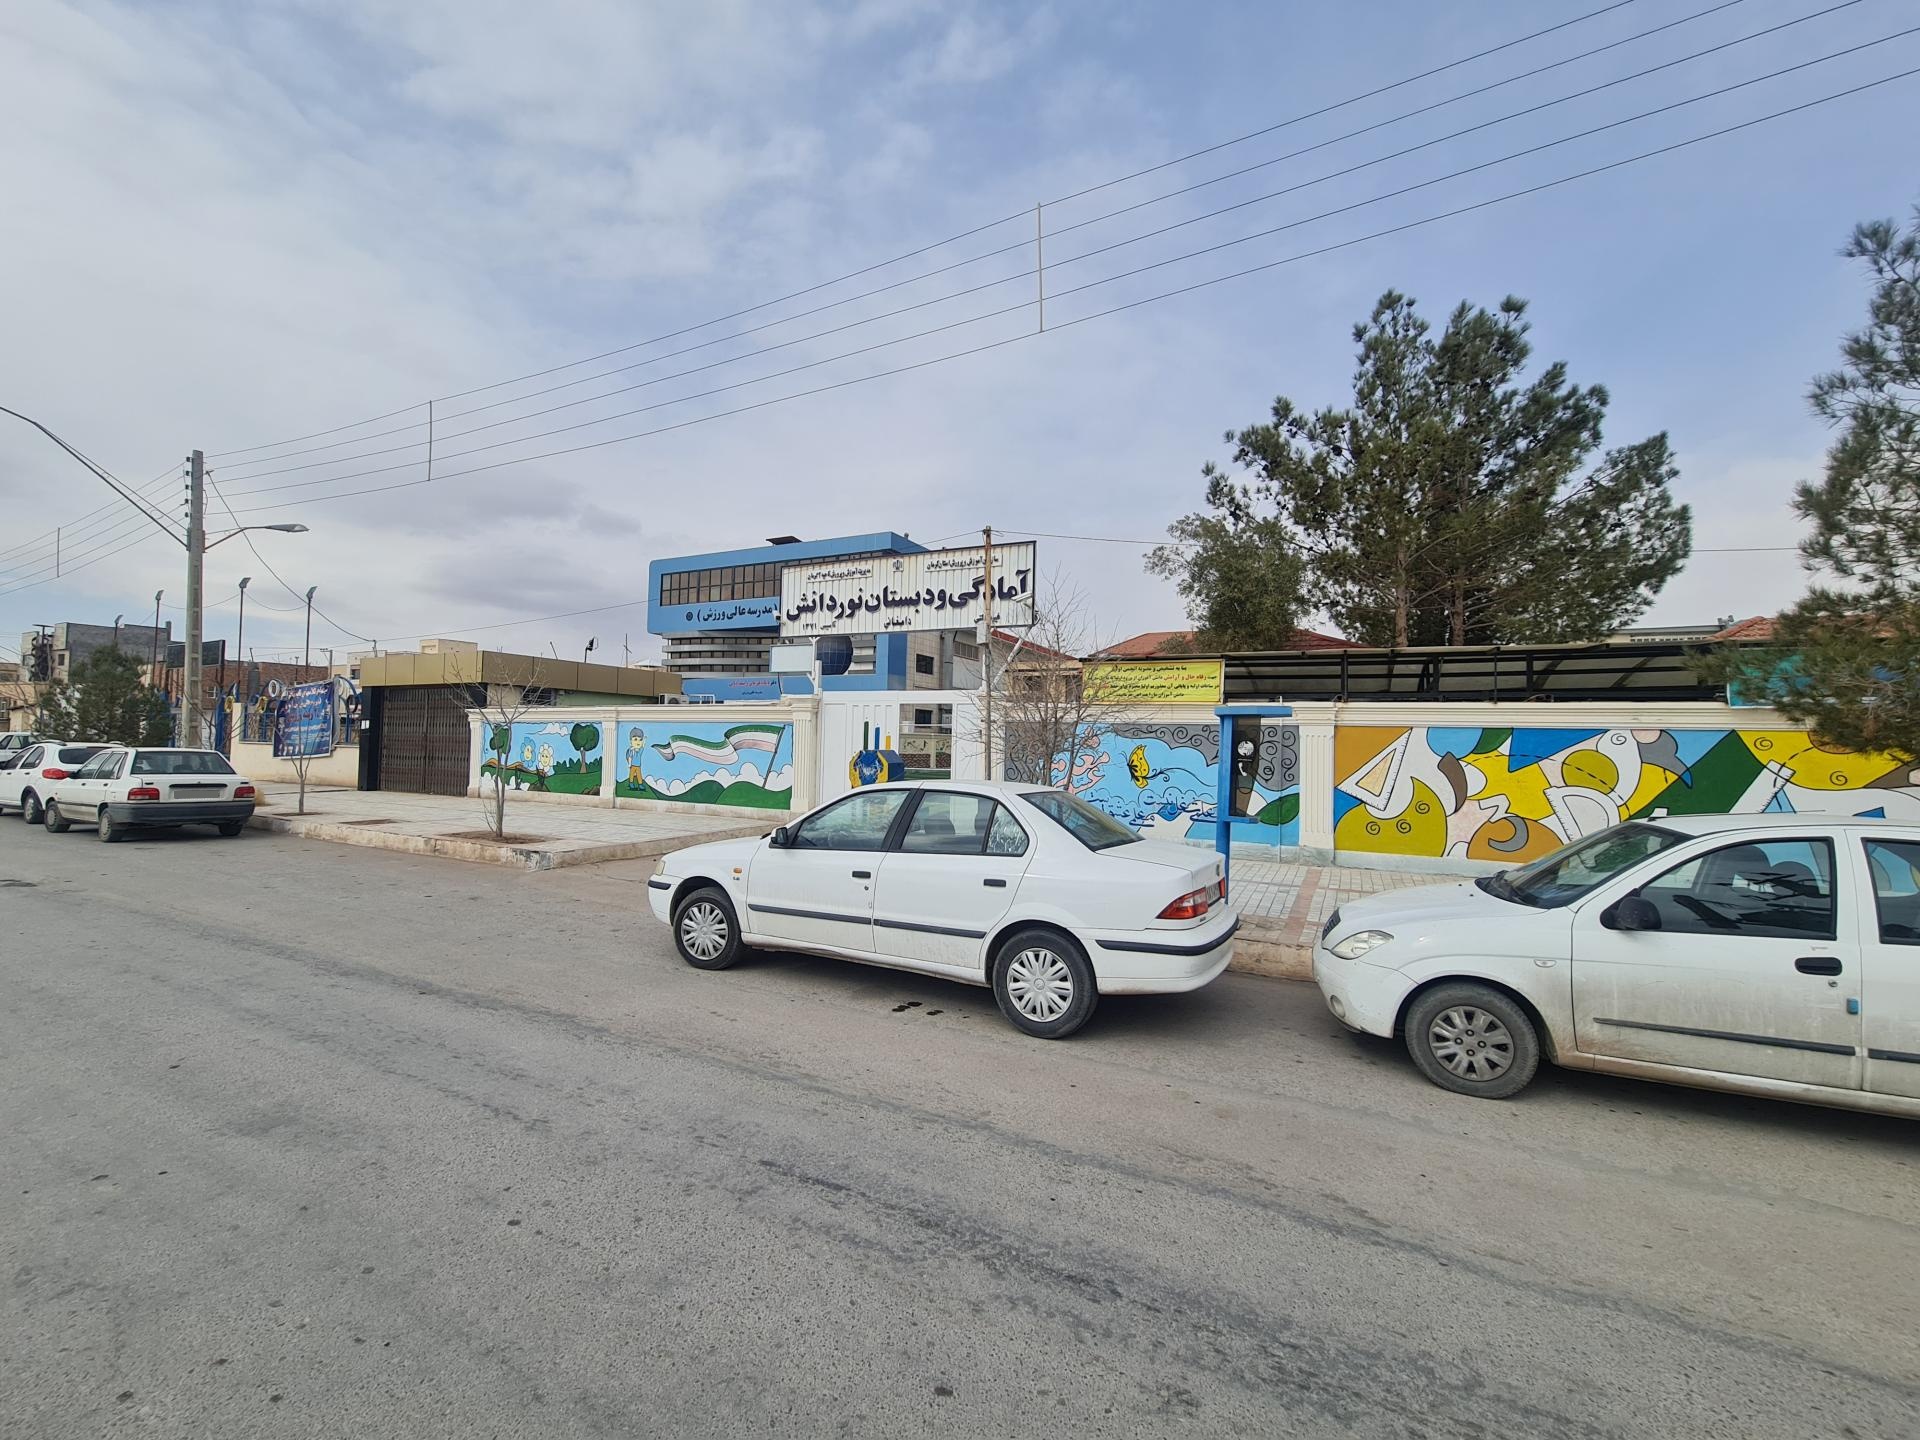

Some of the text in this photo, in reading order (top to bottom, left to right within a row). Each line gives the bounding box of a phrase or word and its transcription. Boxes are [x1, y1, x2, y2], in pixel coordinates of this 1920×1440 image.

[926, 560, 940, 570] کرمان
[726, 605, 746, 620] عالی
[786, 590, 837, 622] دانش
[834, 587, 863, 619] نور
[864, 585, 935, 614] دبستان
